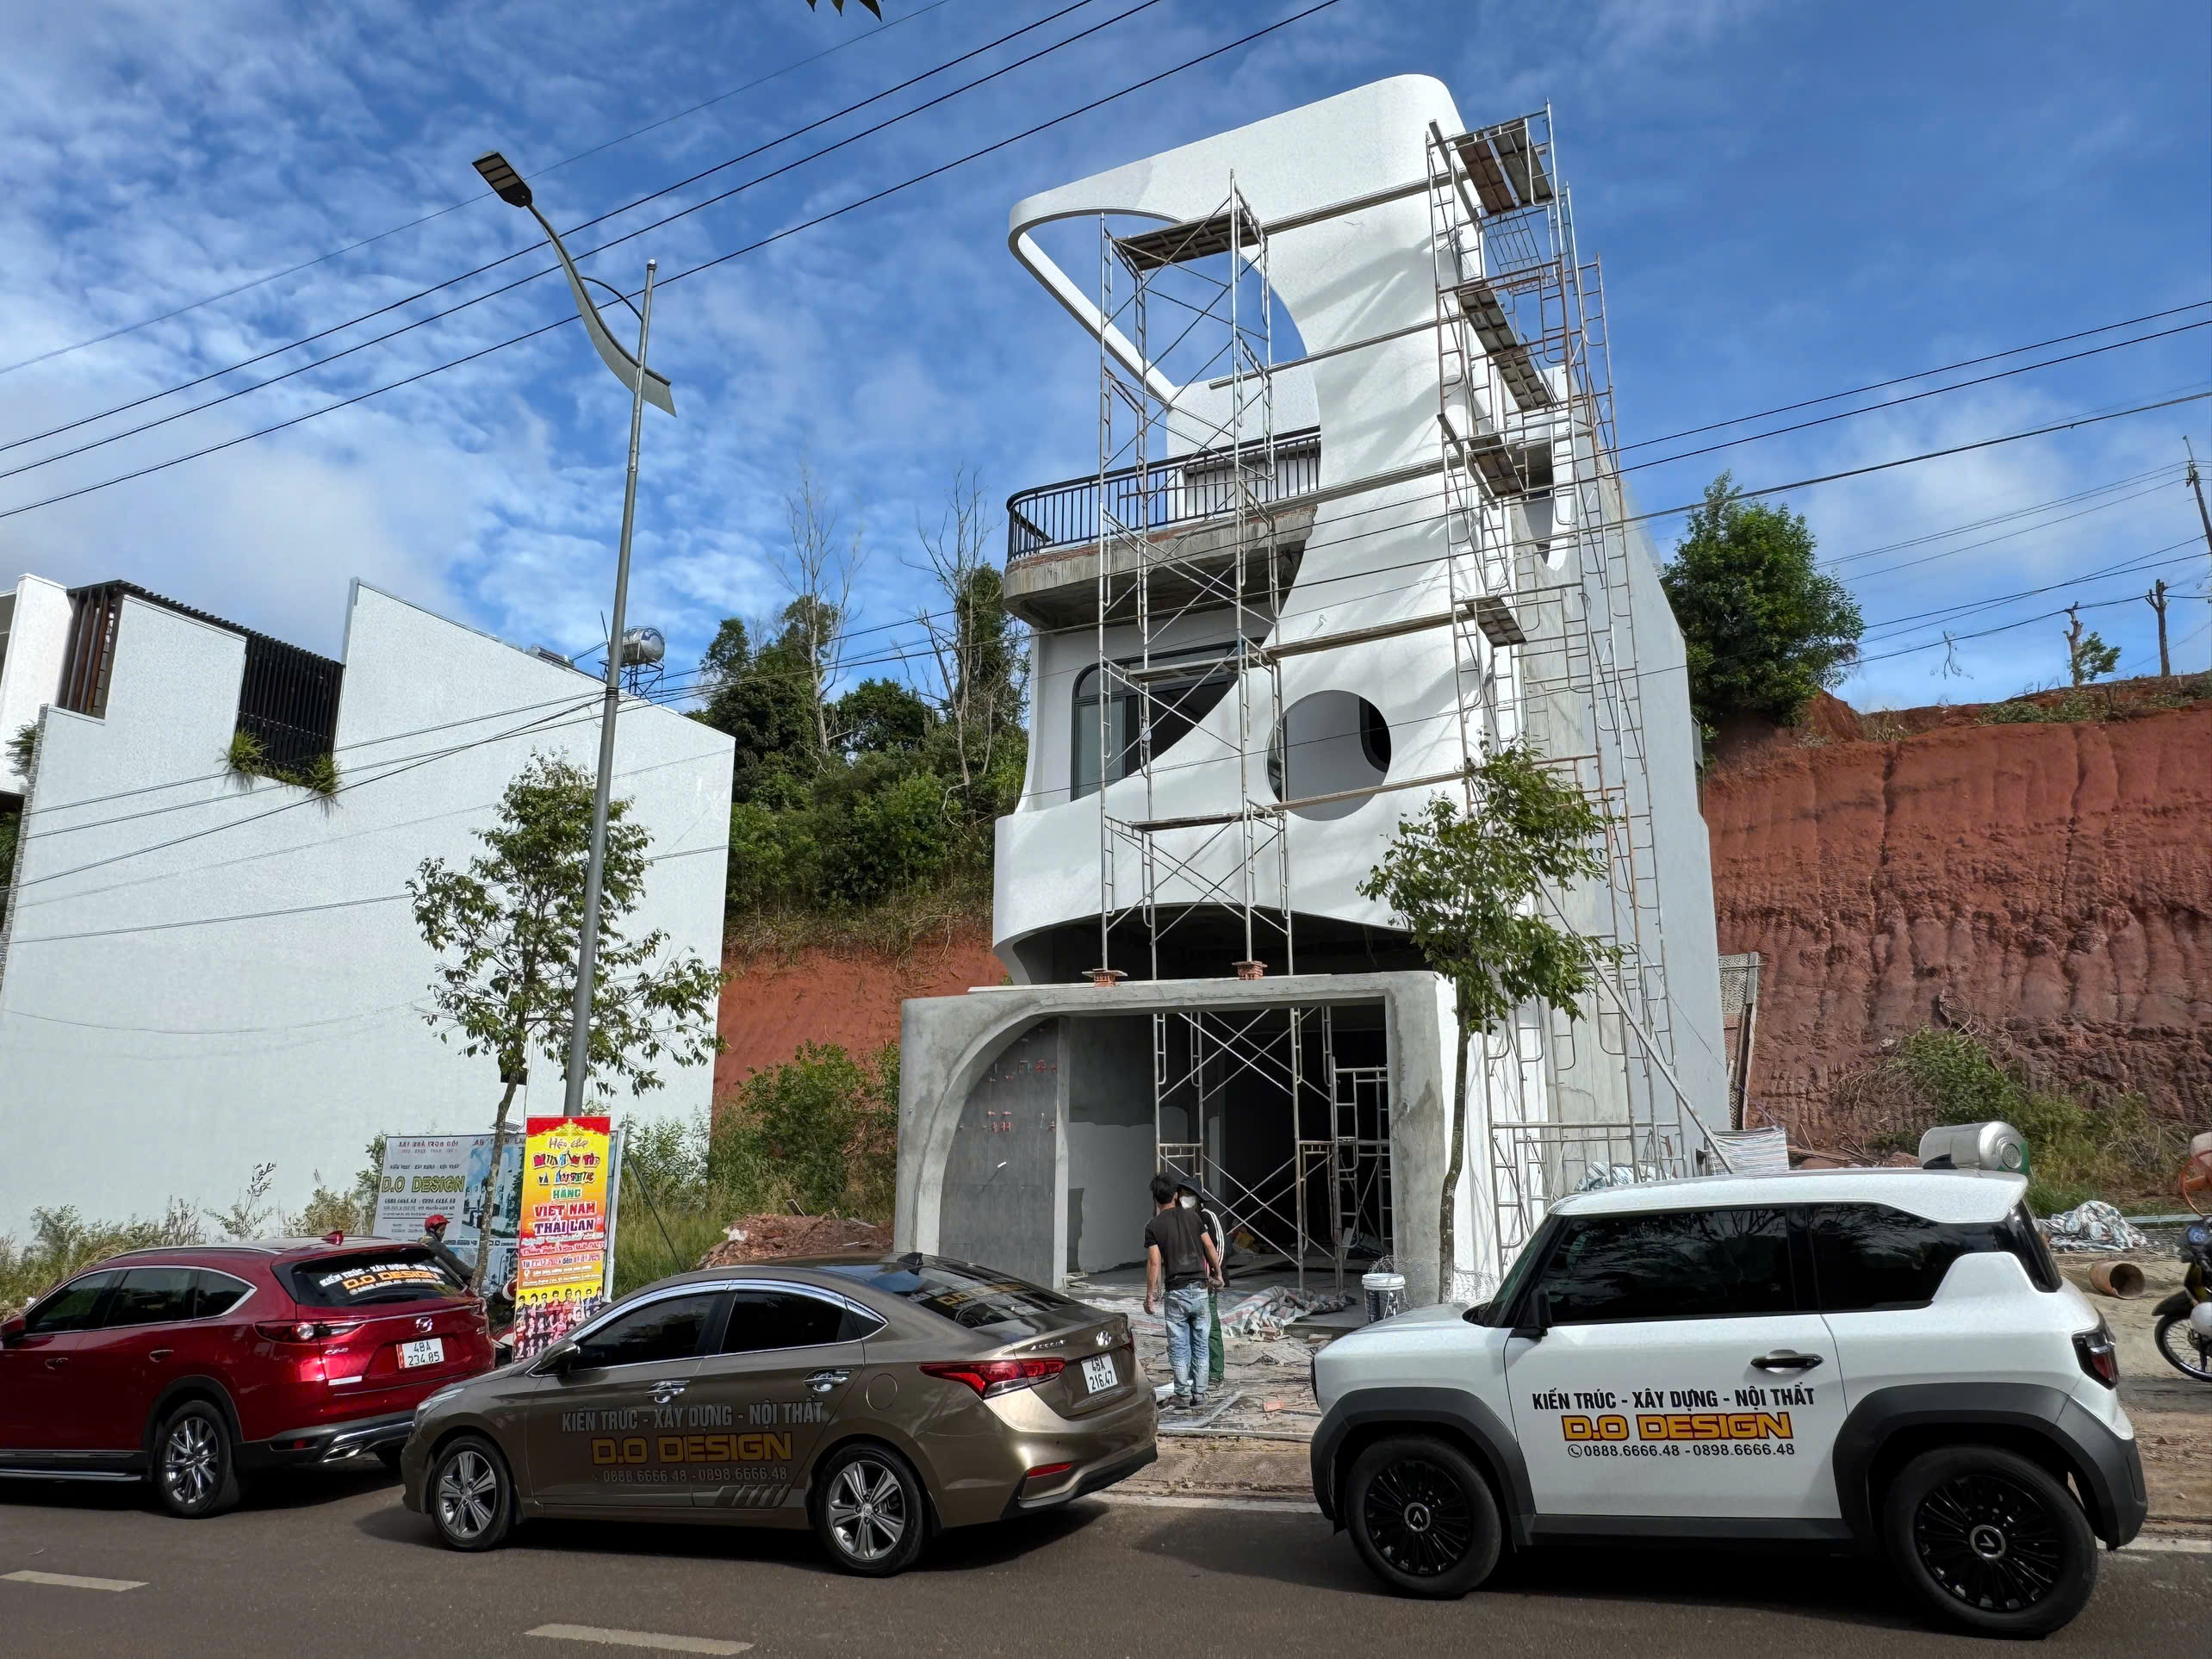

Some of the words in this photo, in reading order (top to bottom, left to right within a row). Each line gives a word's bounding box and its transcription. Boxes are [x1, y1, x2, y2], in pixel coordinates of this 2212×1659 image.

[382, 1176, 406, 1193] D.O
[412, 1176, 465, 1193] DESIGN
[569, 1202, 595, 1215] NAM
[569, 1219, 594, 1232] LAN
[343, 1274, 376, 1289] D.O
[378, 1271, 441, 1281] DESIGN
[413, 1341, 431, 1353] 48A
[1091, 1357, 1106, 1371] 48A
[1090, 1370, 1113, 1391] 216.47
[1532, 1388, 1570, 1410] KIẾN
[1574, 1389, 1616, 1409] TRÚC
[1632, 1388, 1664, 1408] XÂY
[1670, 1389, 1718, 1411] DỰNG
[1735, 1386, 1767, 1410] NỘI
[1770, 1382, 1814, 1406] THẤT
[562, 1406, 596, 1432] KIẾN
[600, 1407, 638, 1431] TRÚC
[654, 1404, 684, 1429] XÂY
[689, 1404, 732, 1432] DỰNG
[749, 1399, 778, 1430] NỘI
[783, 1395, 824, 1423] THẤT
[1561, 1414, 1630, 1441] D.O
[1636, 1412, 1793, 1441] DESIGN
[592, 1437, 648, 1465] D.O
[657, 1431, 792, 1463] DESIGN
[1584, 1445, 1680, 1457] 0888.6666.48
[1693, 1444, 1795, 1457] 0898.6666.48
[699, 1467, 787, 1481] 0898.6666.48
